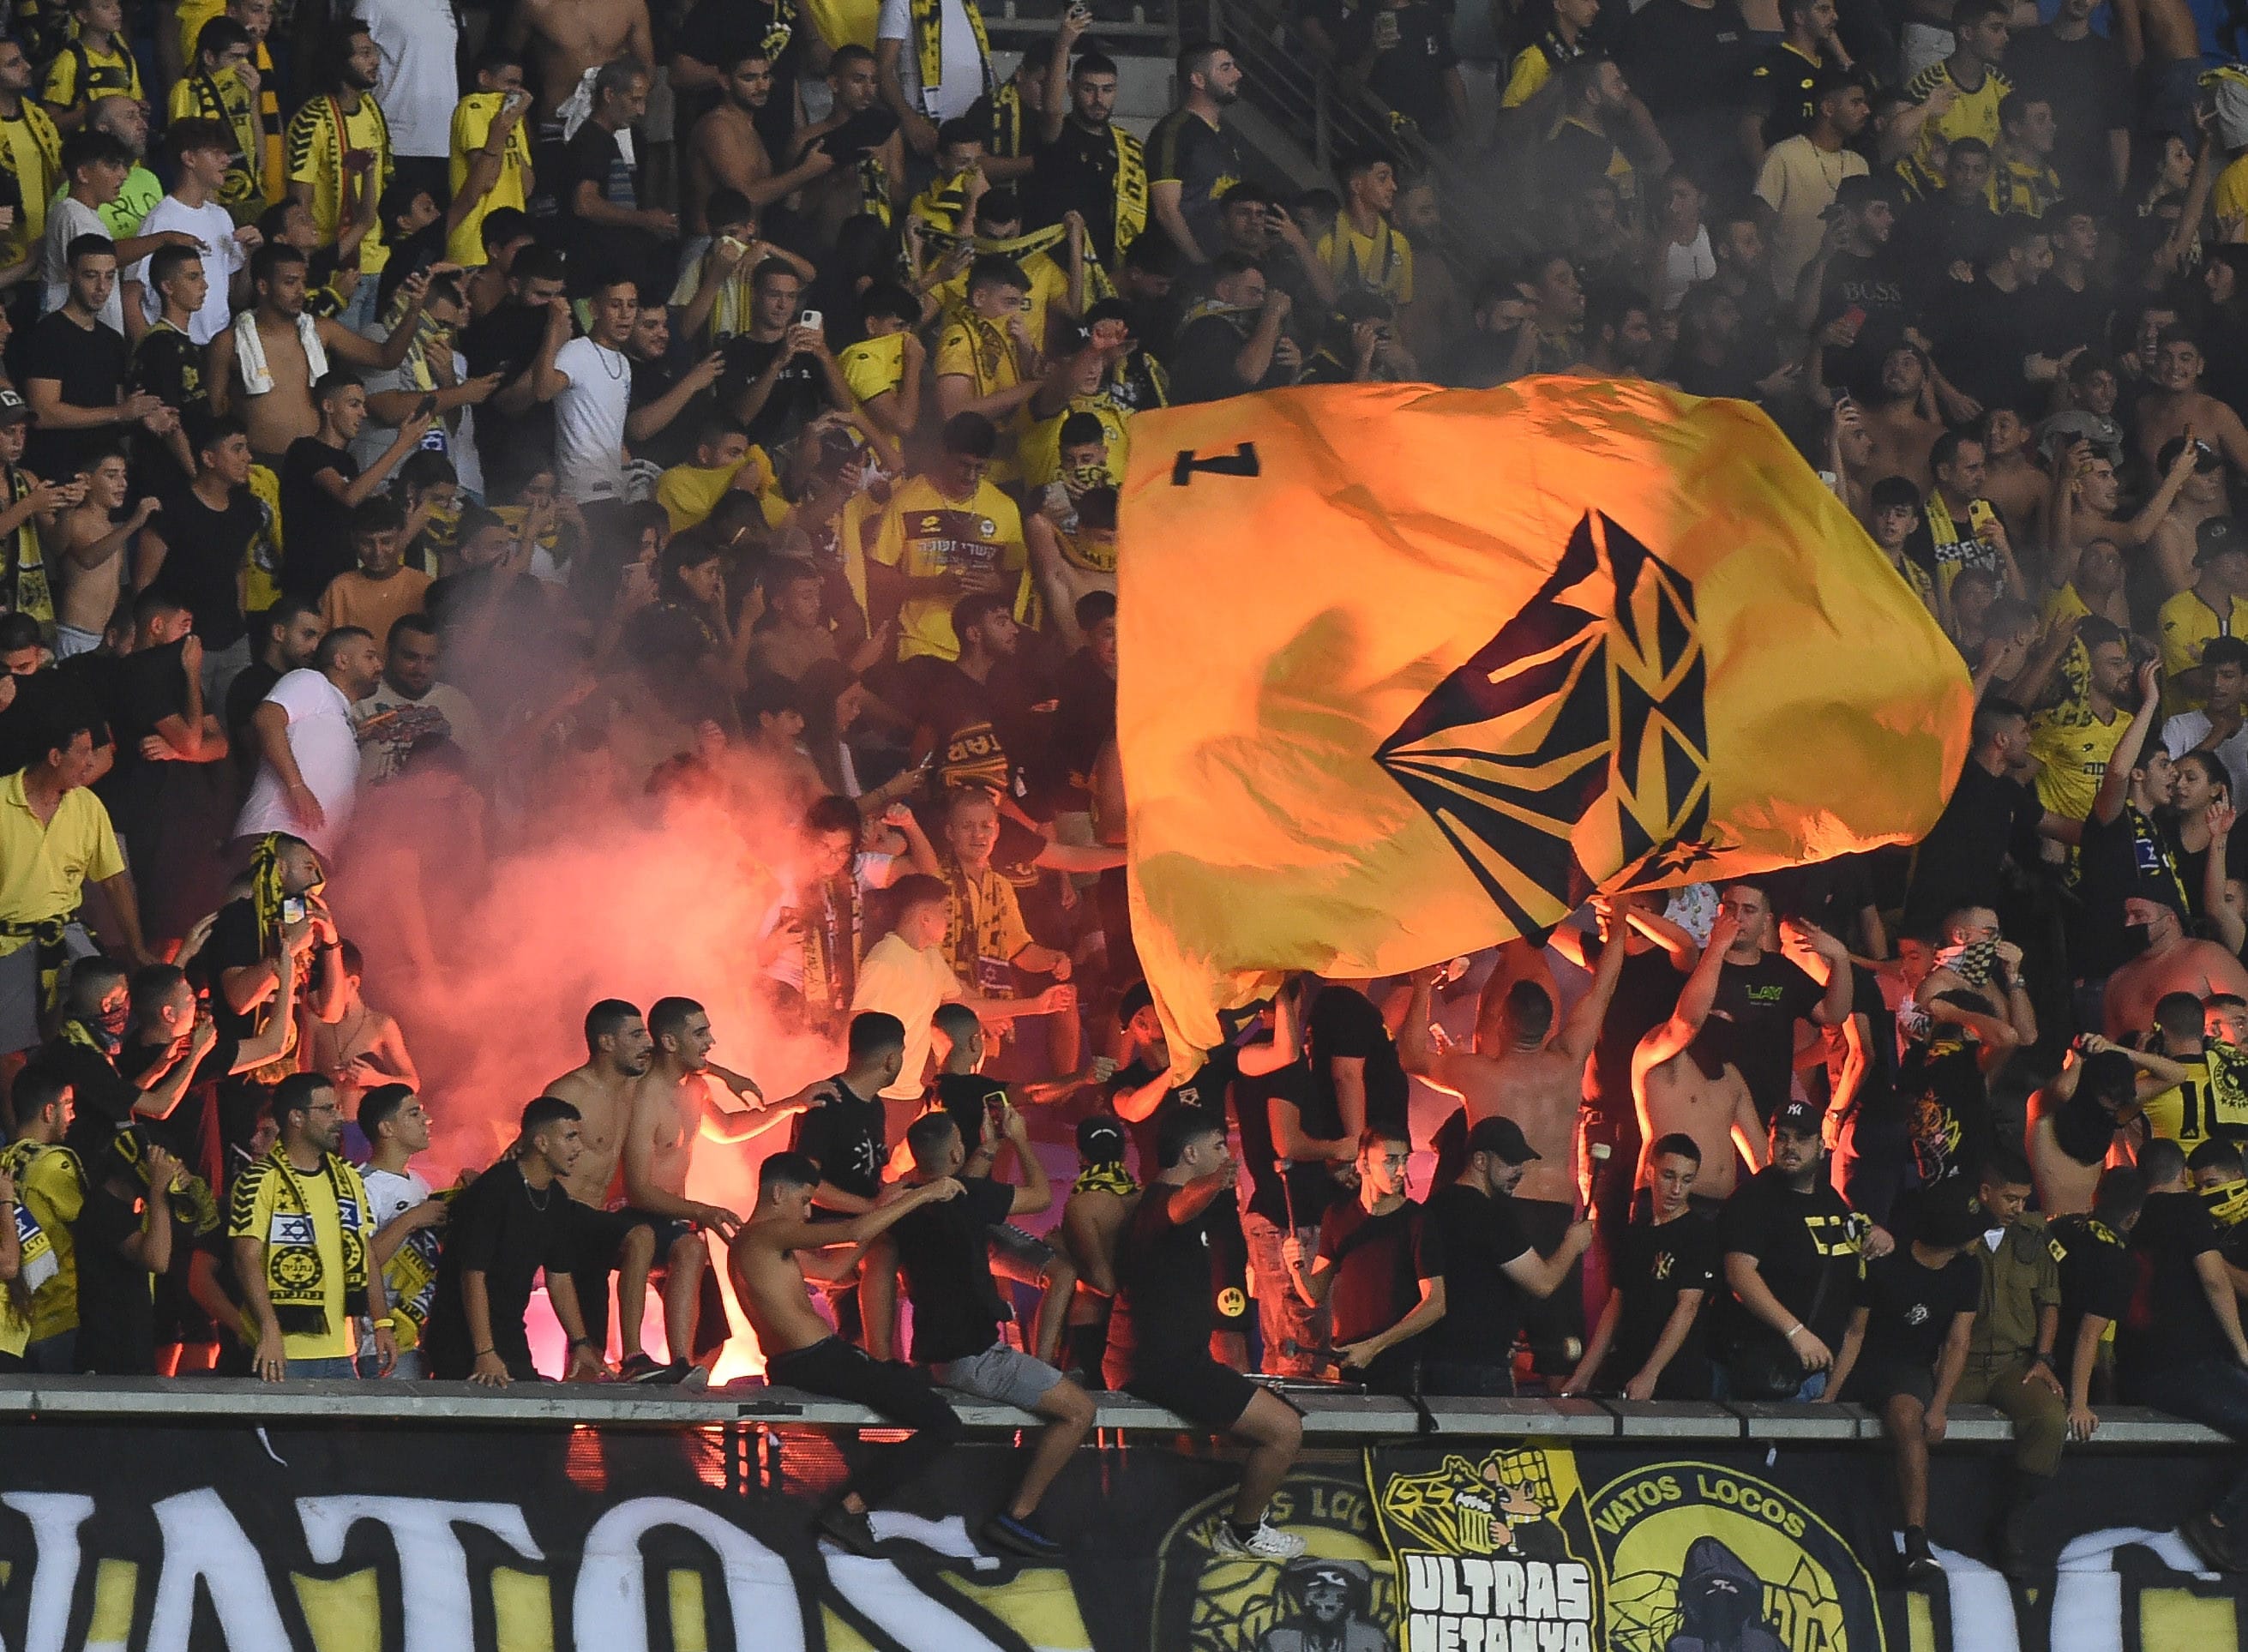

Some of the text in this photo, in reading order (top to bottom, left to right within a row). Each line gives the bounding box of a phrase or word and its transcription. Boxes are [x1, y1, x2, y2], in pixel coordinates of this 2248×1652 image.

[1594, 1474, 1806, 1538] VATOS LOCOS
[1405, 1555, 1590, 1620] ULTRAS
